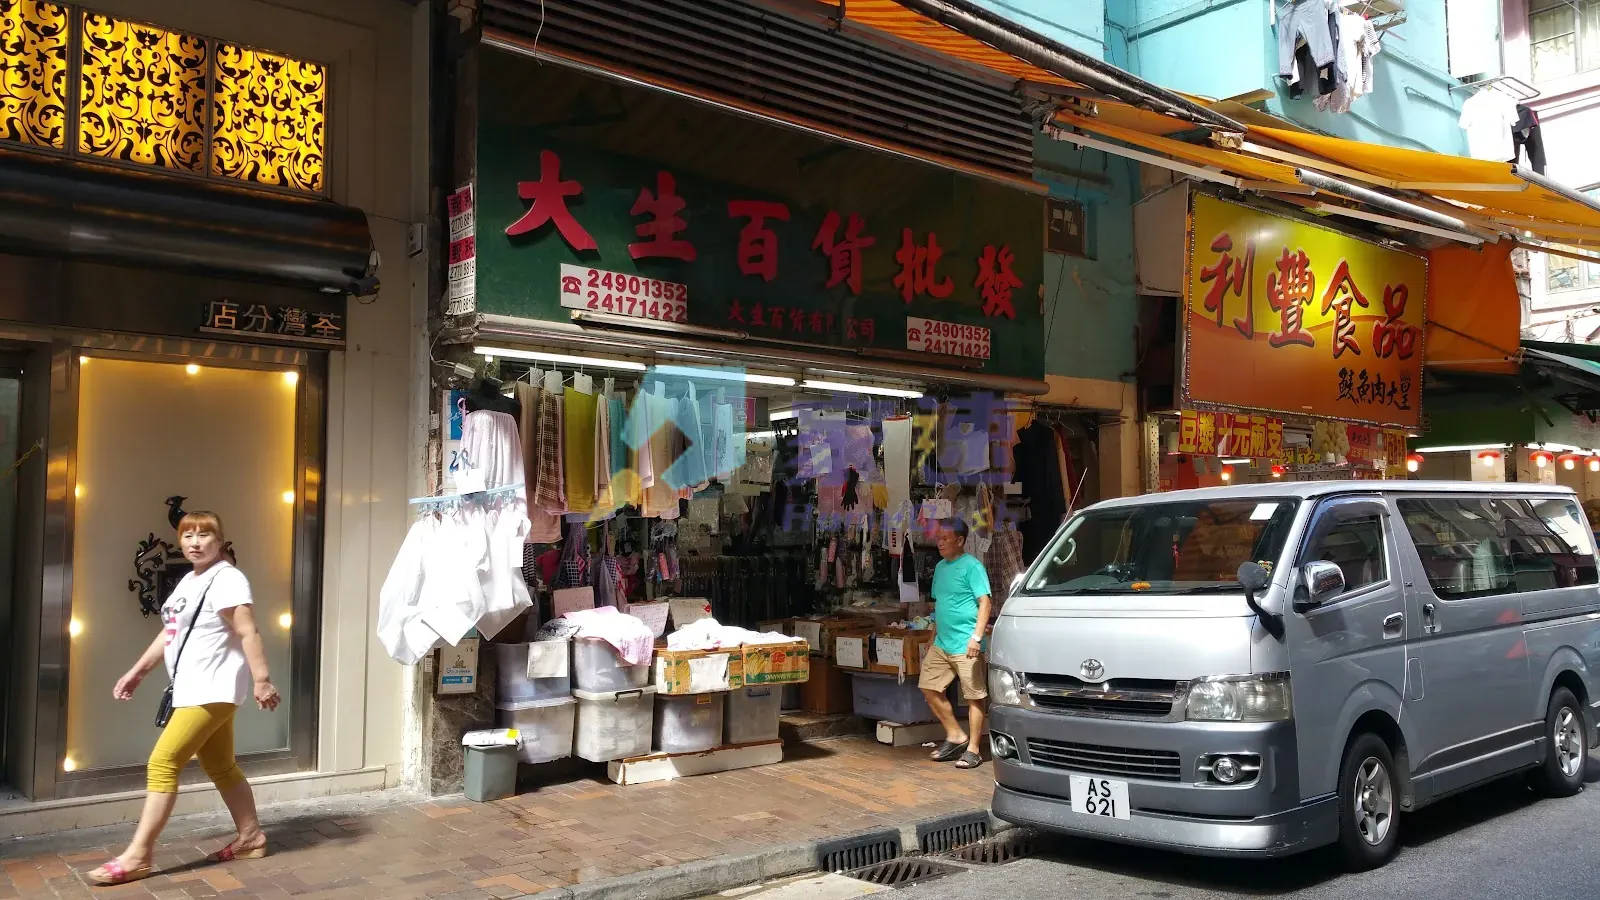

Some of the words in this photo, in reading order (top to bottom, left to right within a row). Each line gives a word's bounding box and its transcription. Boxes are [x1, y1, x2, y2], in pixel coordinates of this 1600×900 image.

[505, 150, 1023, 320] 大生百貨批發
[587, 269, 686, 302] 24901352
[1200, 232, 1417, 360] 利豐食品
[586, 290, 687, 322] 24171422
[924, 320, 990, 343] 24901352
[924, 338, 990, 359] 24171422
[1180, 409, 1282, 457] 豆漿十元兩支
[1087, 778, 1111, 798] AS
[1085, 796, 1115, 818] 621
